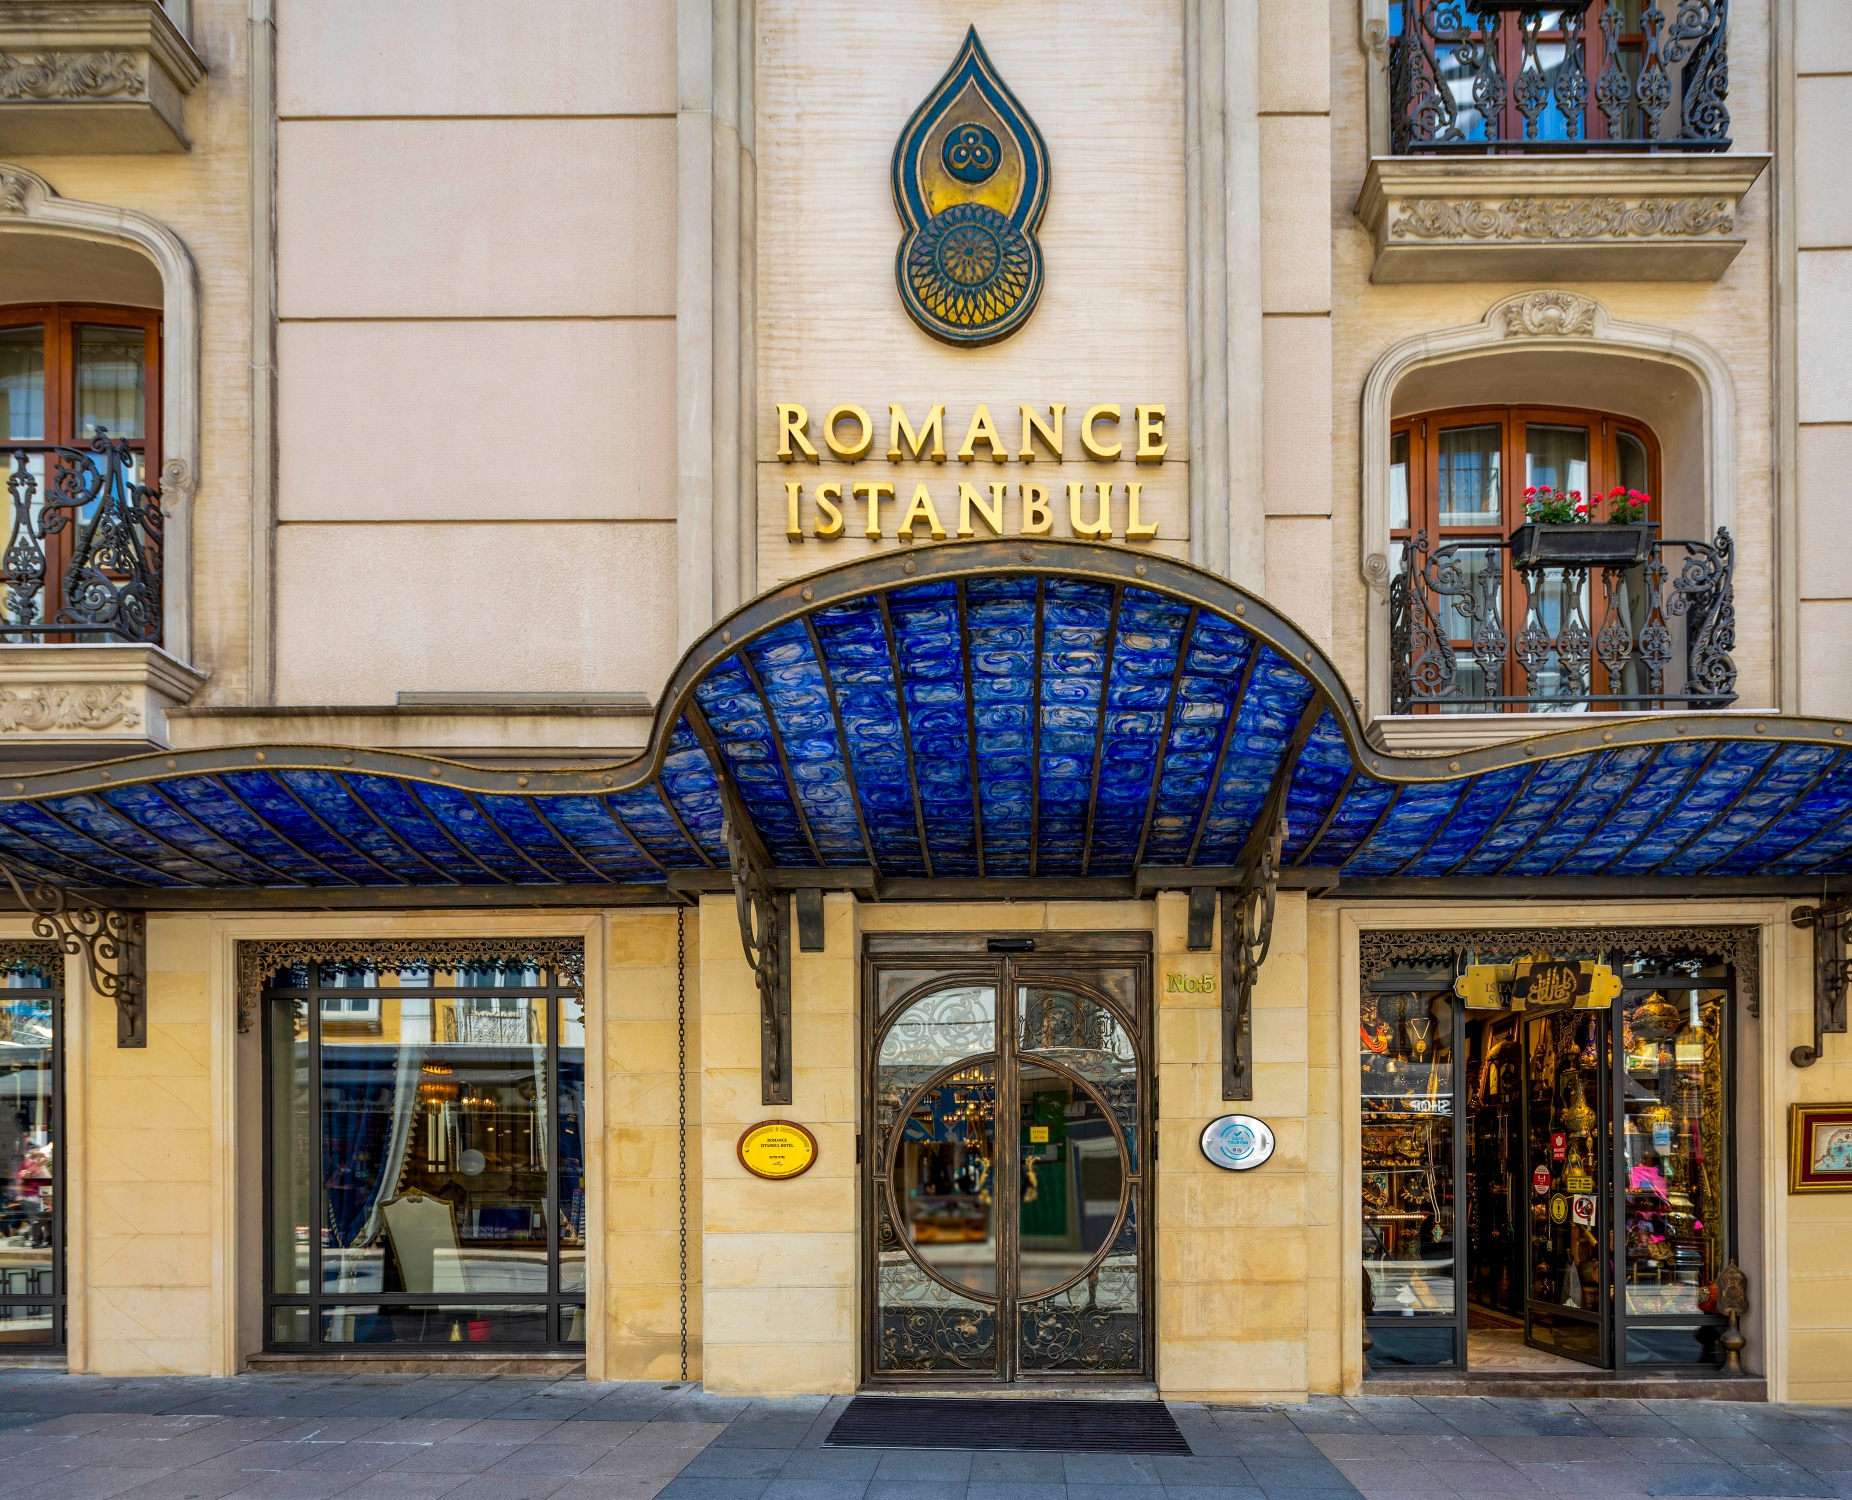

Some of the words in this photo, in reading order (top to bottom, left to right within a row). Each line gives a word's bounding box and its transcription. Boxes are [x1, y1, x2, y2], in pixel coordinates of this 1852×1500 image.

[776, 403, 1168, 463] ROMANCE
[784, 482, 1159, 541] ISTANBUL
[1167, 972, 1216, 993] No:5
